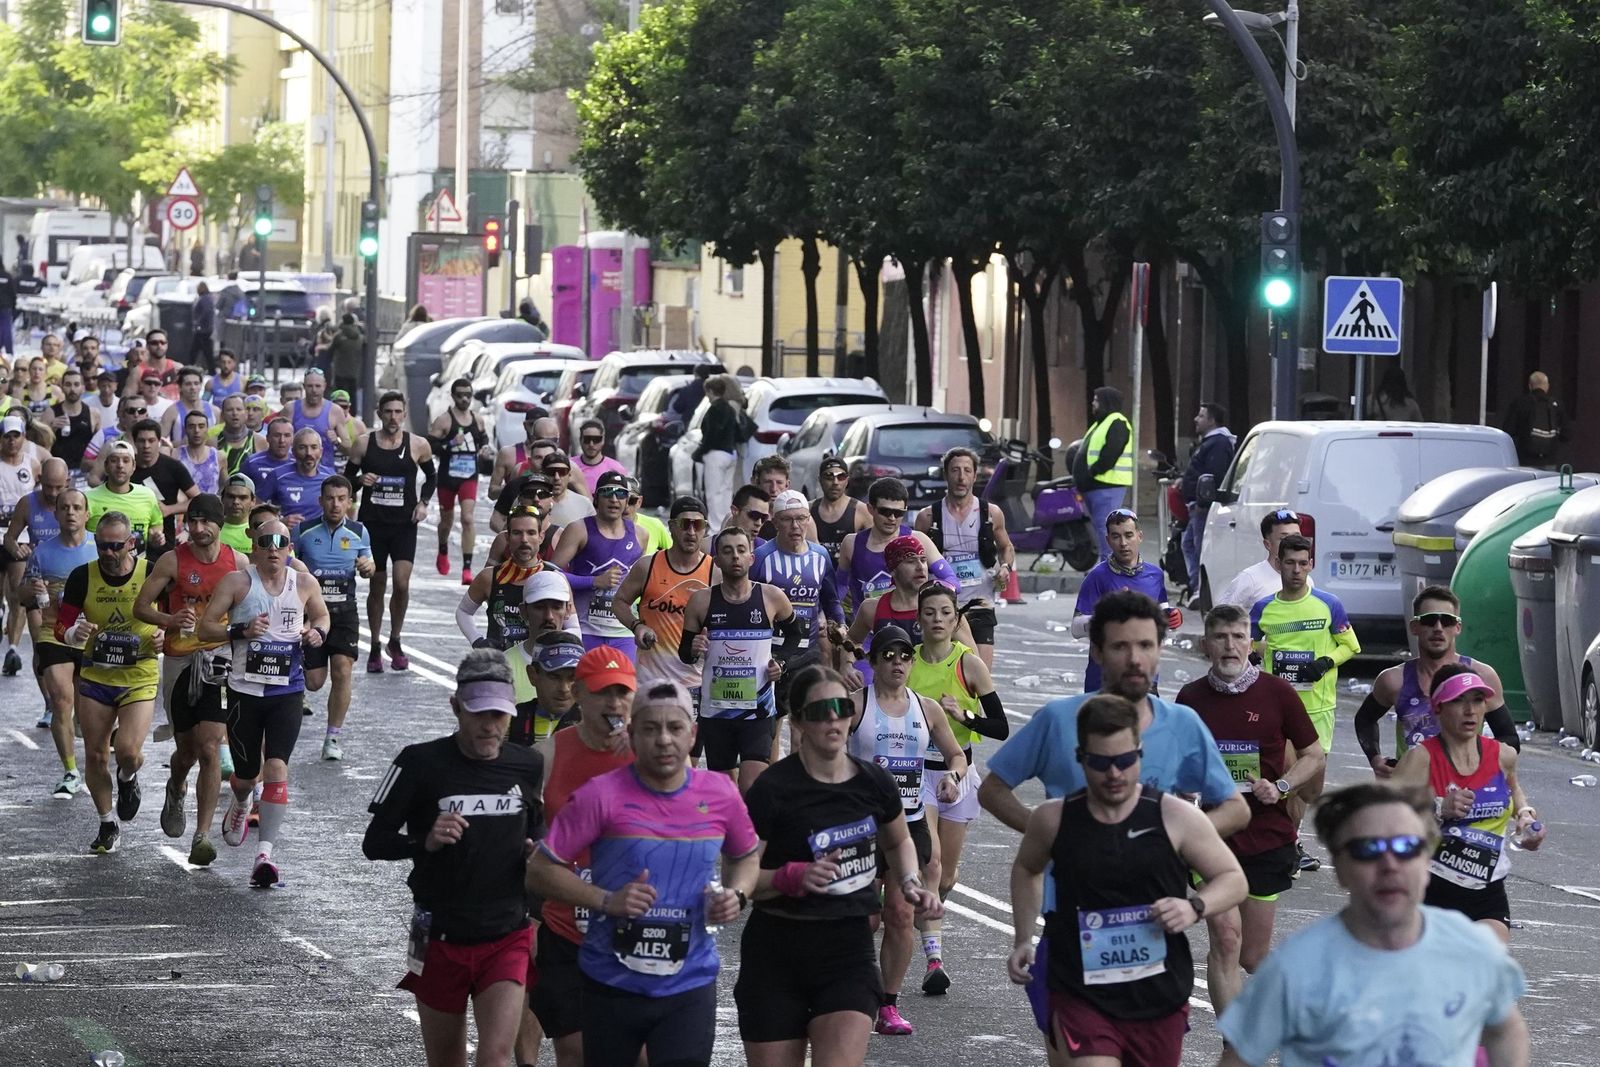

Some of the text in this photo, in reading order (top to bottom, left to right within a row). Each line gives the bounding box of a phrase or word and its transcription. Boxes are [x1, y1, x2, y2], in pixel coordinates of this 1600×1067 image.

[174, 208, 193, 220] 30
[1340, 564, 1396, 576] 9177 MFY
[790, 585, 818, 597] GÖTA
[106, 654, 124, 664] TANI
[257, 664, 280, 674] JOHN
[722, 690, 744, 699] UNAI
[832, 823, 870, 841] ZURICH
[1466, 831, 1496, 847] ZURICH
[1462, 847, 1480, 860] 4434
[1440, 850, 1489, 880] CANSINA
[644, 908, 686, 918] ZURICH
[642, 928, 666, 938] 5200
[632, 941, 672, 958] ALEX
[1100, 946, 1150, 966] SALAS
